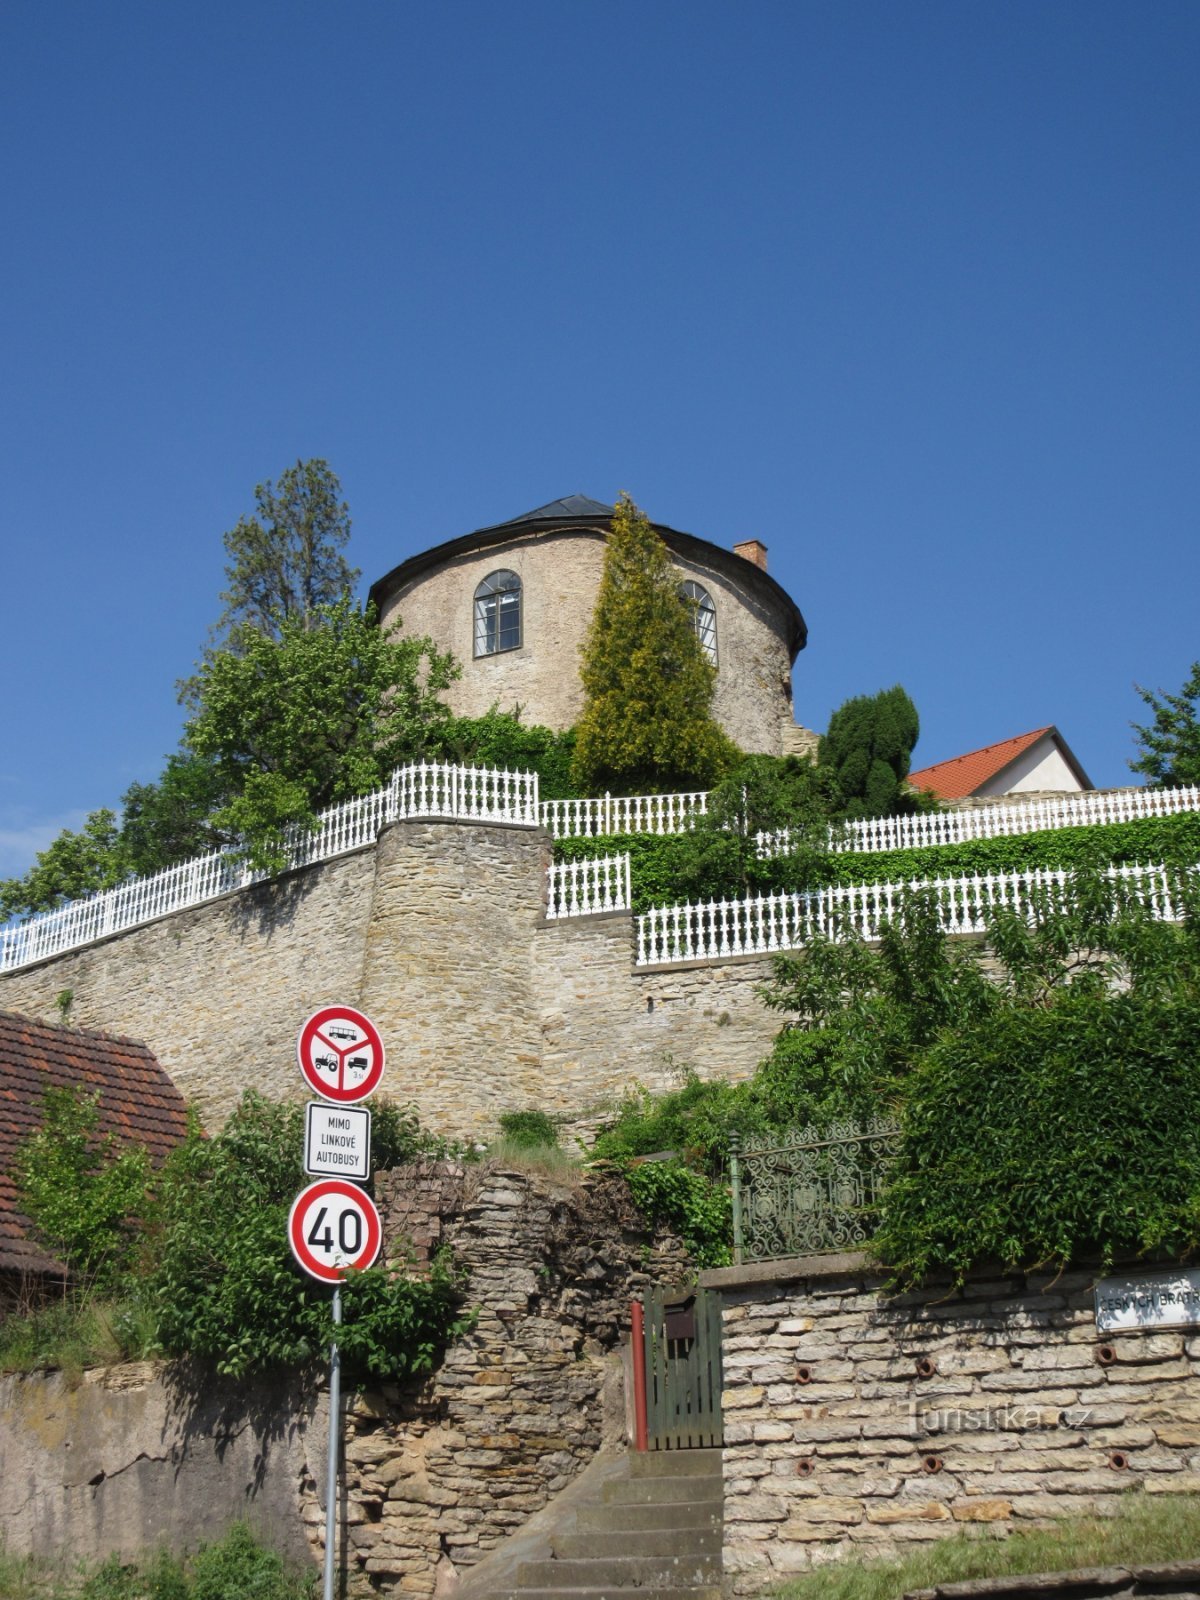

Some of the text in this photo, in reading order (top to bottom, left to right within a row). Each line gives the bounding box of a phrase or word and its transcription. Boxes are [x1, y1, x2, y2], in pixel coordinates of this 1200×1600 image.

[328, 1117, 351, 1130] MIMO
[321, 1133, 356, 1149] LINKOVÉ
[316, 1151, 360, 1167] AUTOBUSY
[308, 1207, 362, 1254] 40
